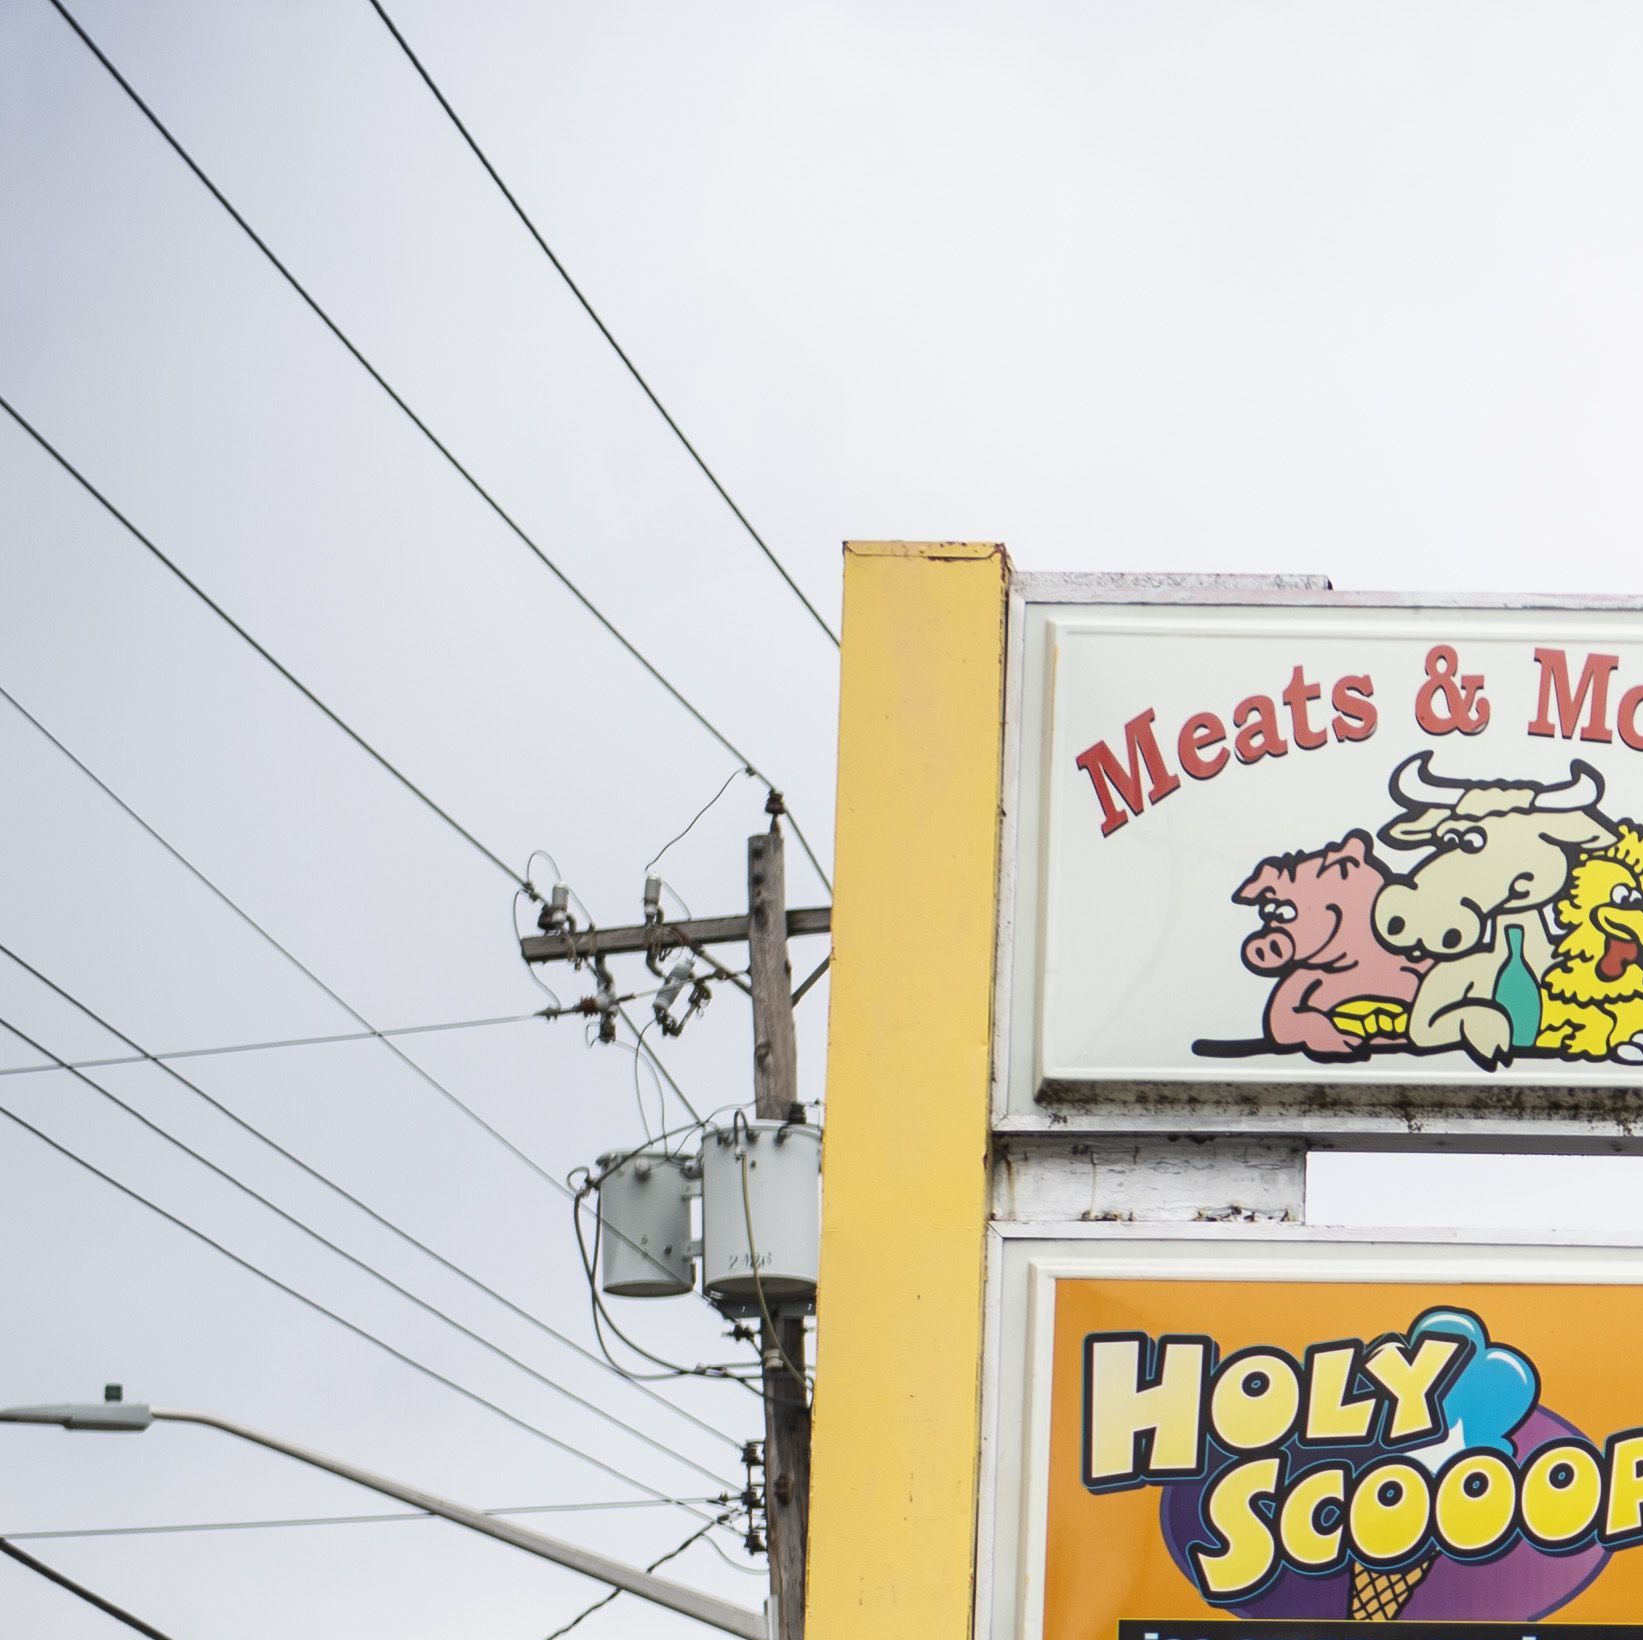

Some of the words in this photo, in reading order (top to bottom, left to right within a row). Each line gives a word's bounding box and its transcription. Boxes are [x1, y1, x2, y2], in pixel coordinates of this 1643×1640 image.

[1077, 664, 1378, 838] Meats
[1415, 645, 1491, 736] &
[1085, 1334, 1470, 1486] HOLY
